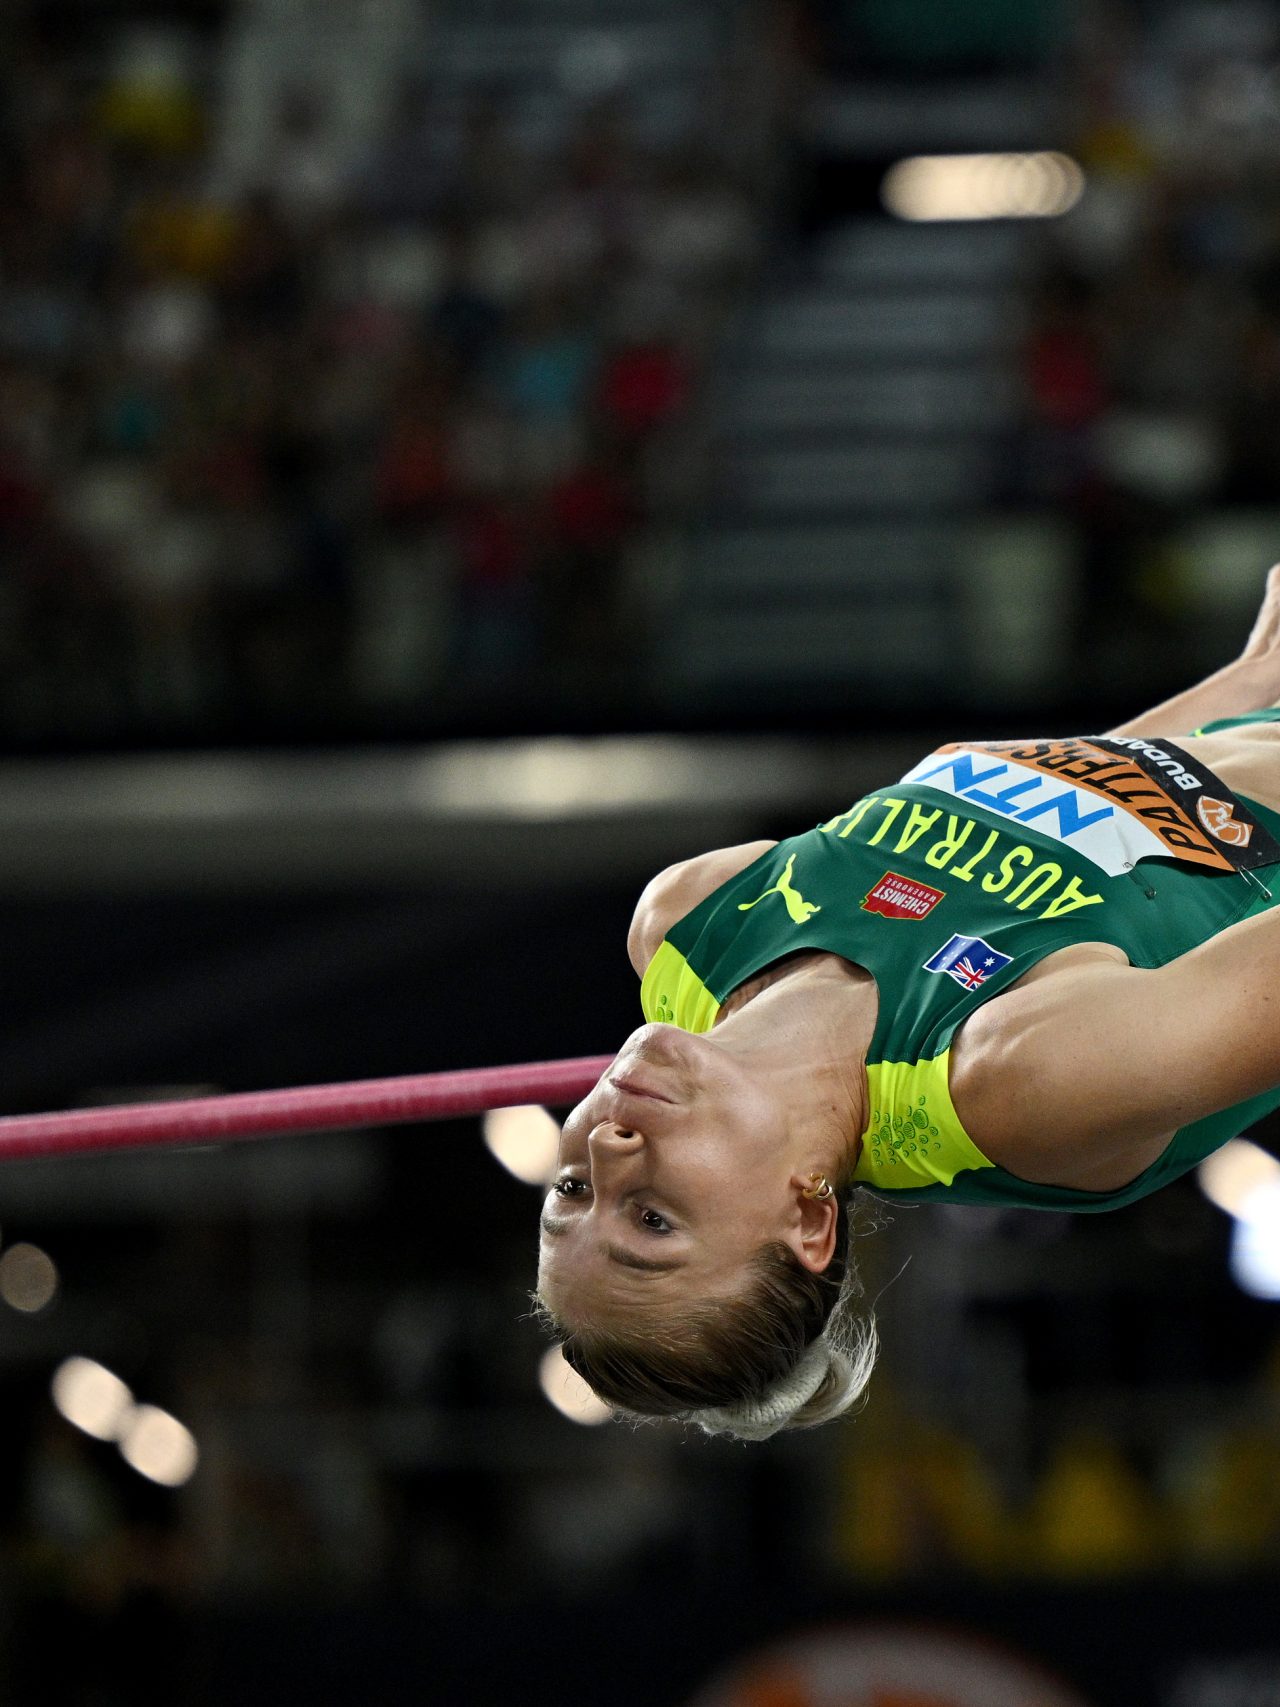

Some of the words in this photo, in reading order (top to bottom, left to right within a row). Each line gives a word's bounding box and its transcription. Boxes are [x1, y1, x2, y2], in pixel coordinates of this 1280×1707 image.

[1105, 736, 1203, 791] BUDAP
[911, 753, 1114, 839] NTN
[872, 885, 931, 915] CHEMIST
[884, 877, 937, 903] WAREHOUSE
